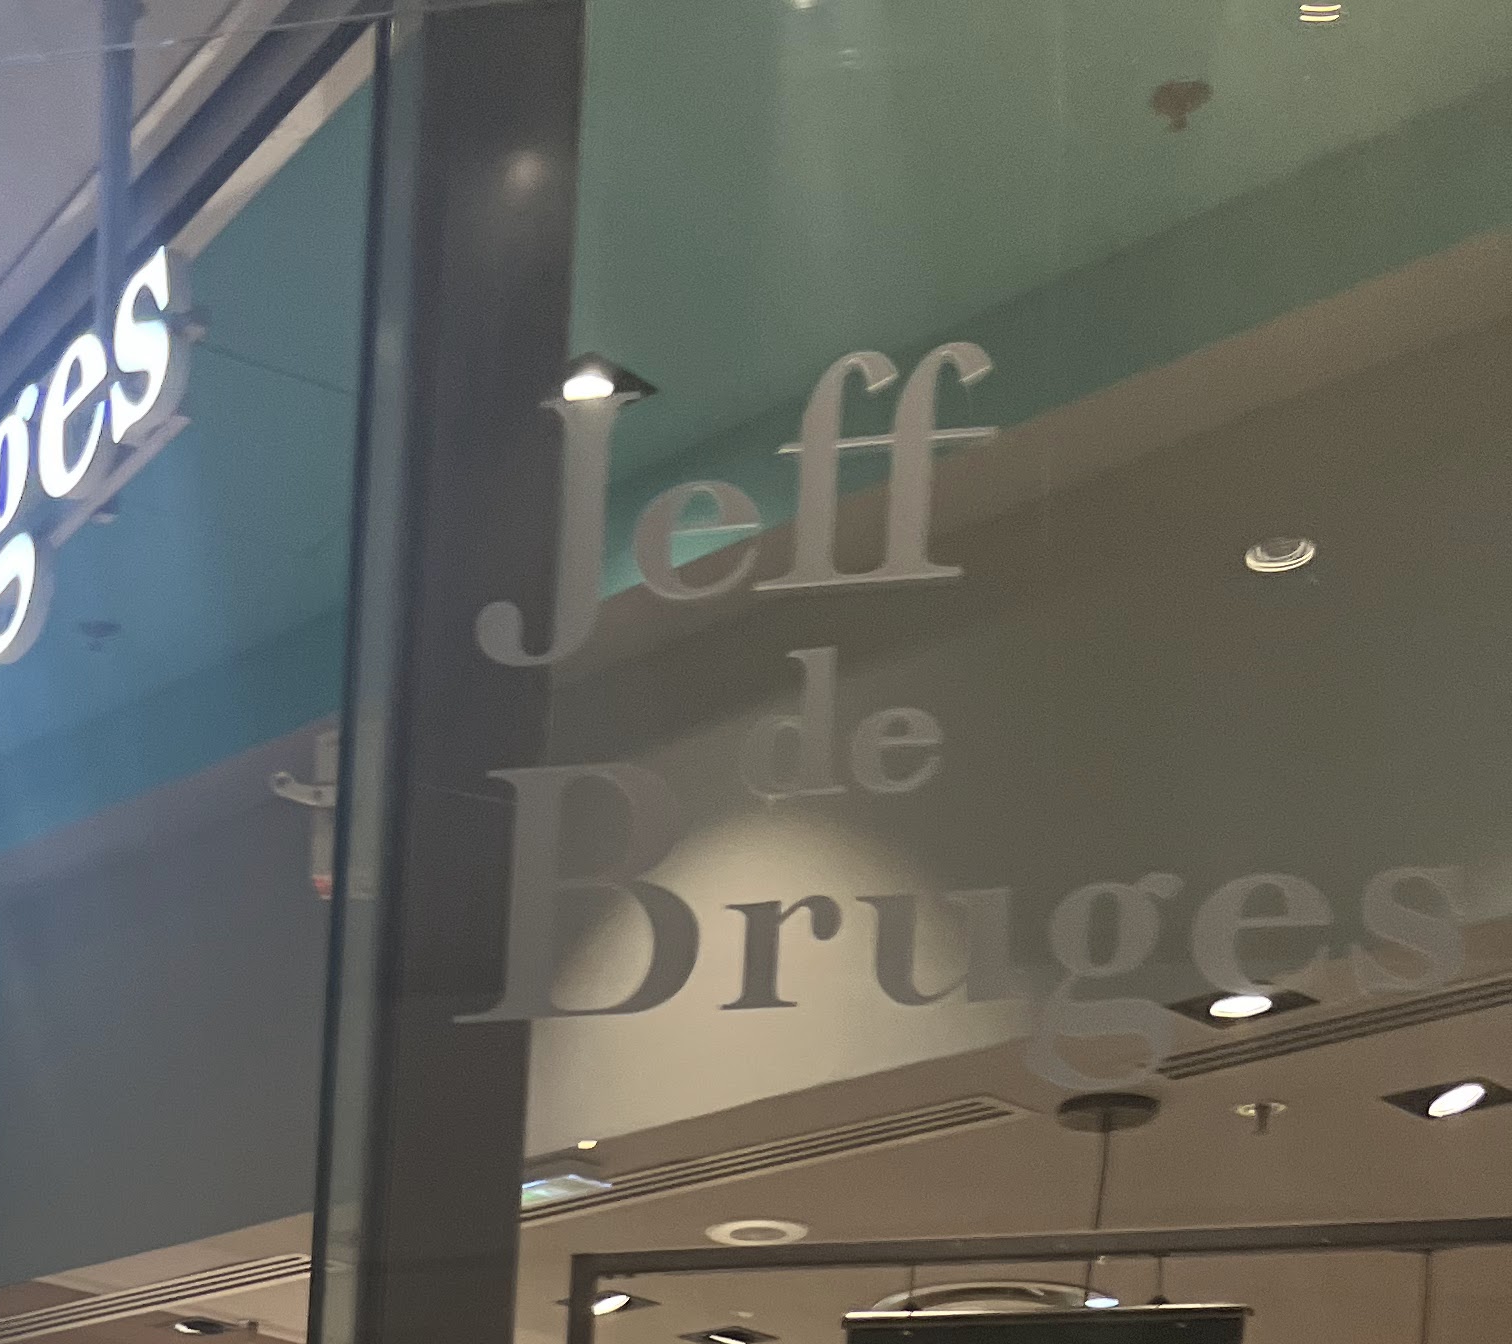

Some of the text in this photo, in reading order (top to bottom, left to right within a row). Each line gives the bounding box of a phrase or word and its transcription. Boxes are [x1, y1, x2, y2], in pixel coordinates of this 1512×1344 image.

[476, 342, 996, 667] Jeff
[737, 647, 944, 803] de
[454, 762, 1468, 1091] Bruges
